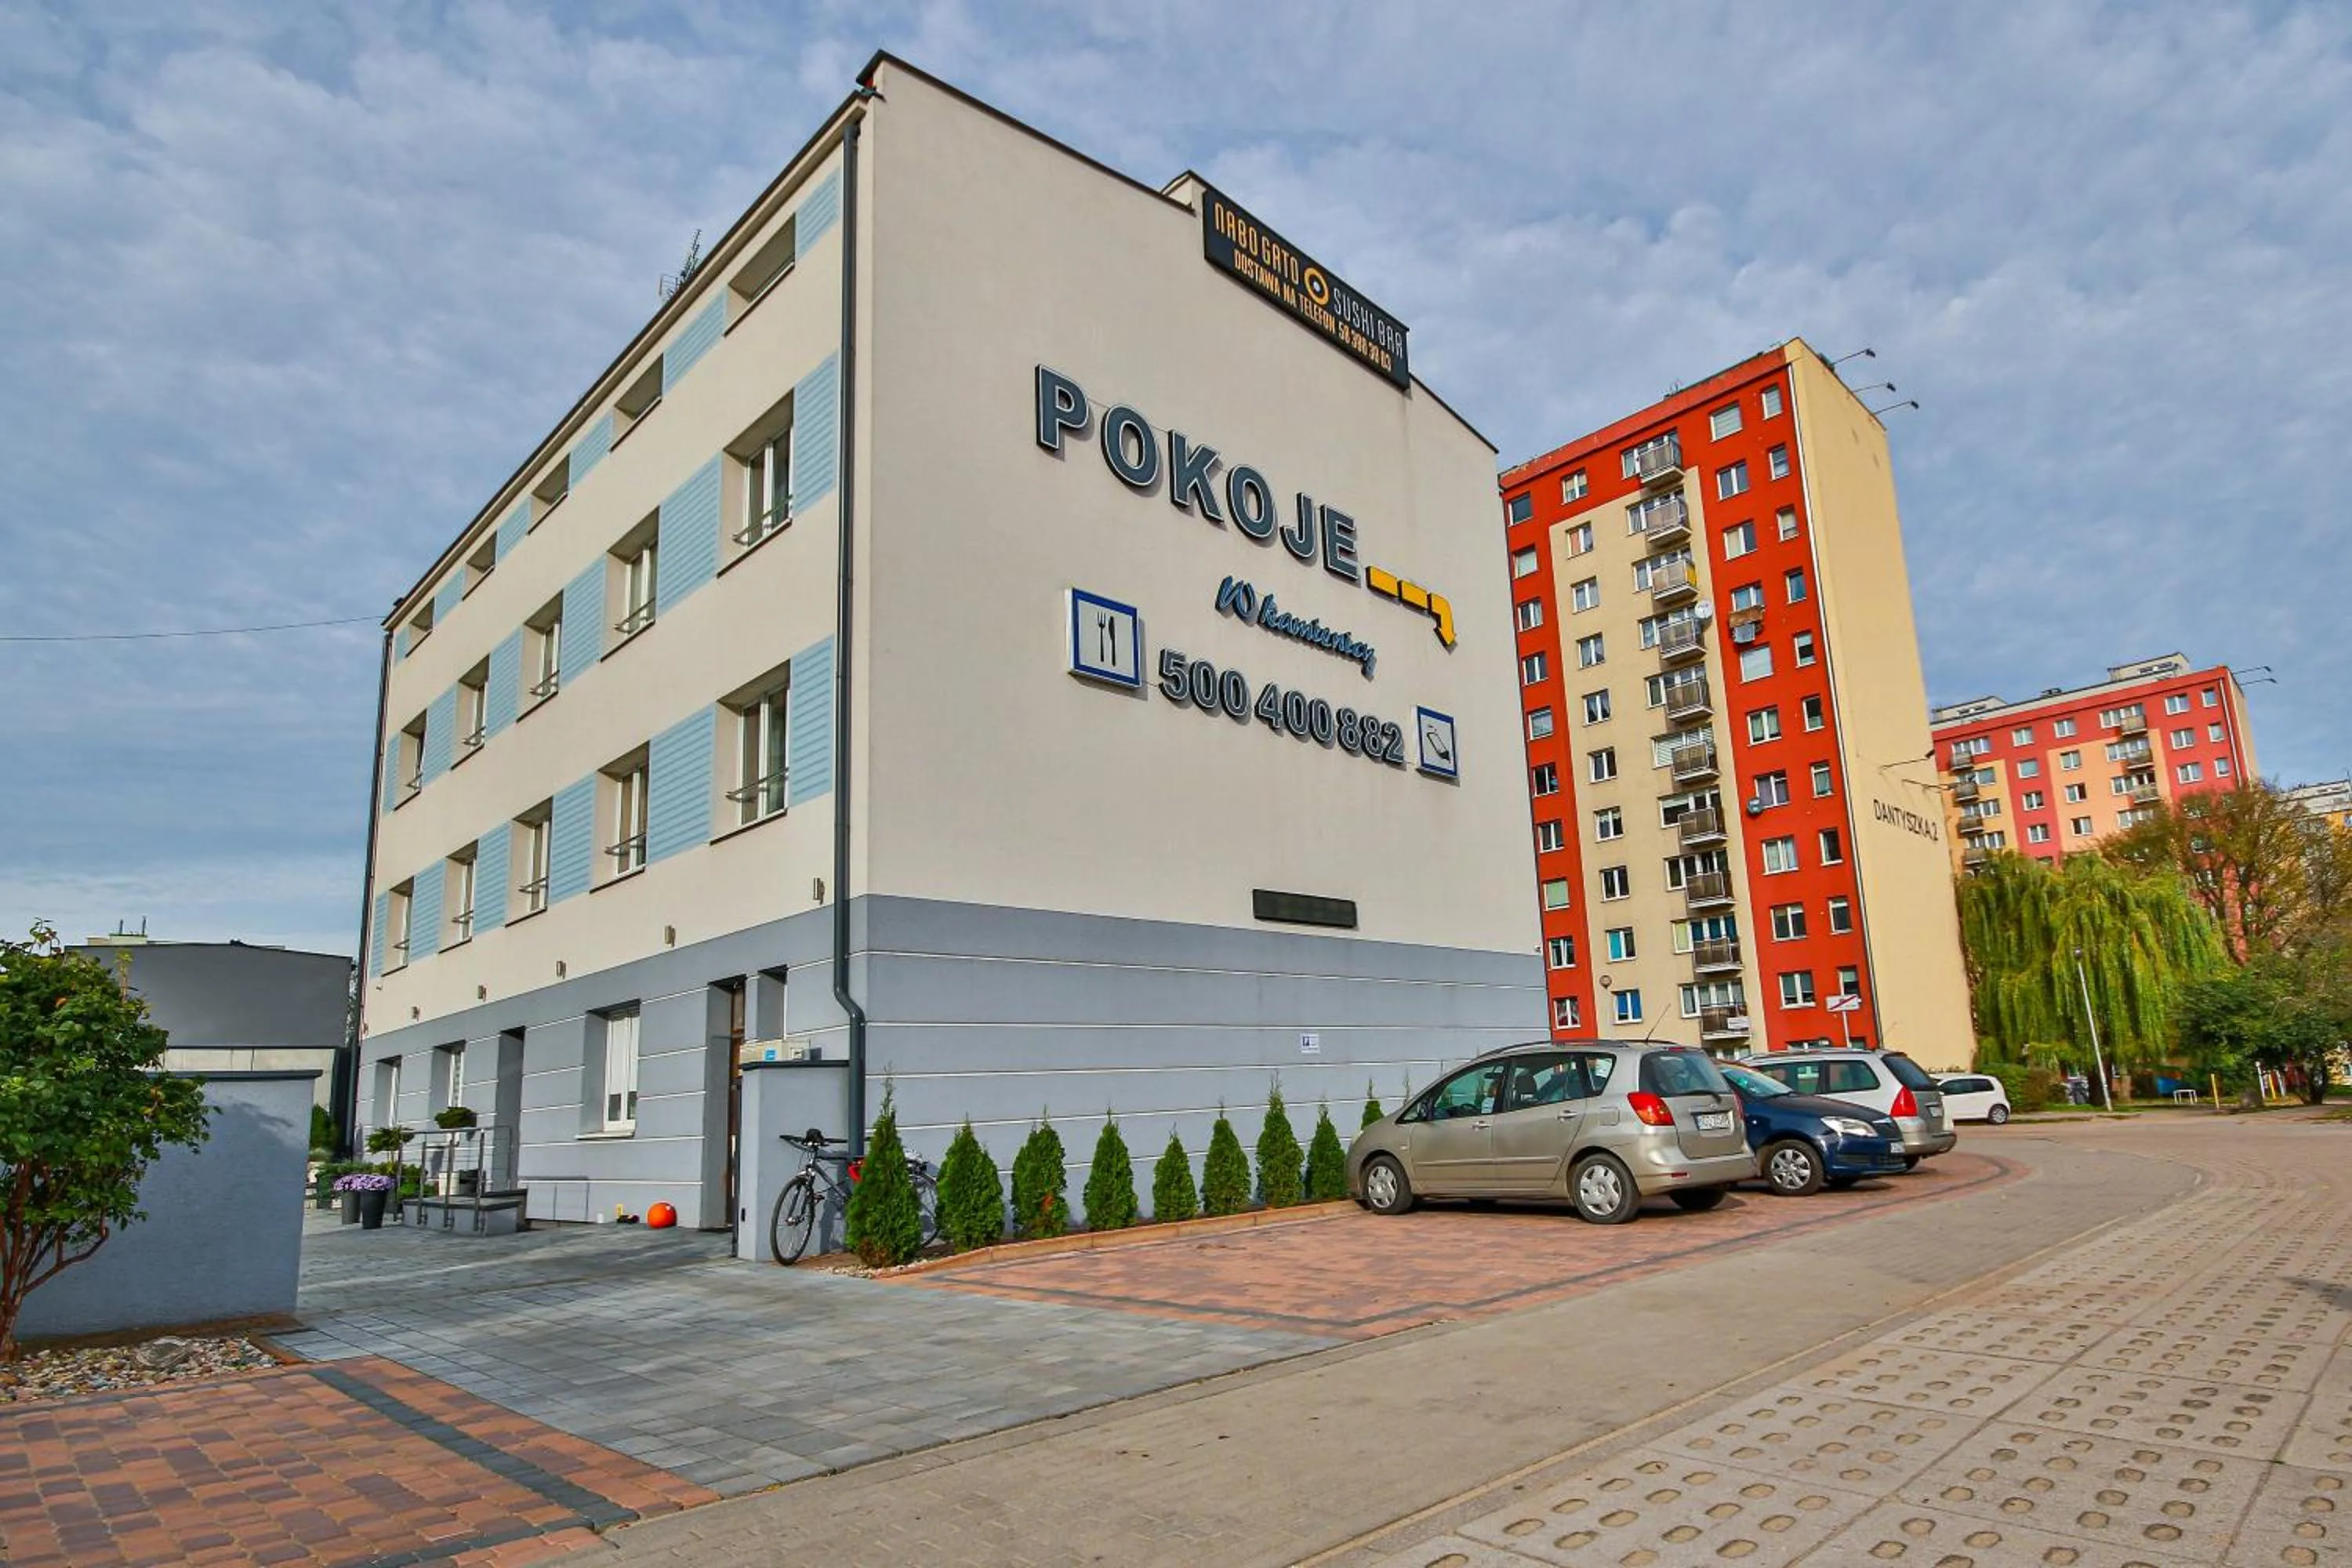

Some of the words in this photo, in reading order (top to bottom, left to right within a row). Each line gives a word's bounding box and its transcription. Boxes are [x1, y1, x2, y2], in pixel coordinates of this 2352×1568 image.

[1215, 202, 1258, 256] NABO
[1261, 236, 1299, 284] GATO
[1334, 288, 1374, 339] SUSHI
[1377, 319, 1403, 358] BAR
[1234, 249, 1281, 296] DOSTAWA
[1283, 283, 1298, 308] NA
[1298, 293, 1335, 334] TELEFON
[1035, 364, 1358, 579] POKOJE
[1159, 648, 1250, 717] 500
[1255, 681, 1334, 745] 400
[1336, 707, 1406, 763] 882
[1873, 798, 1932, 838] DANTYSZKA
